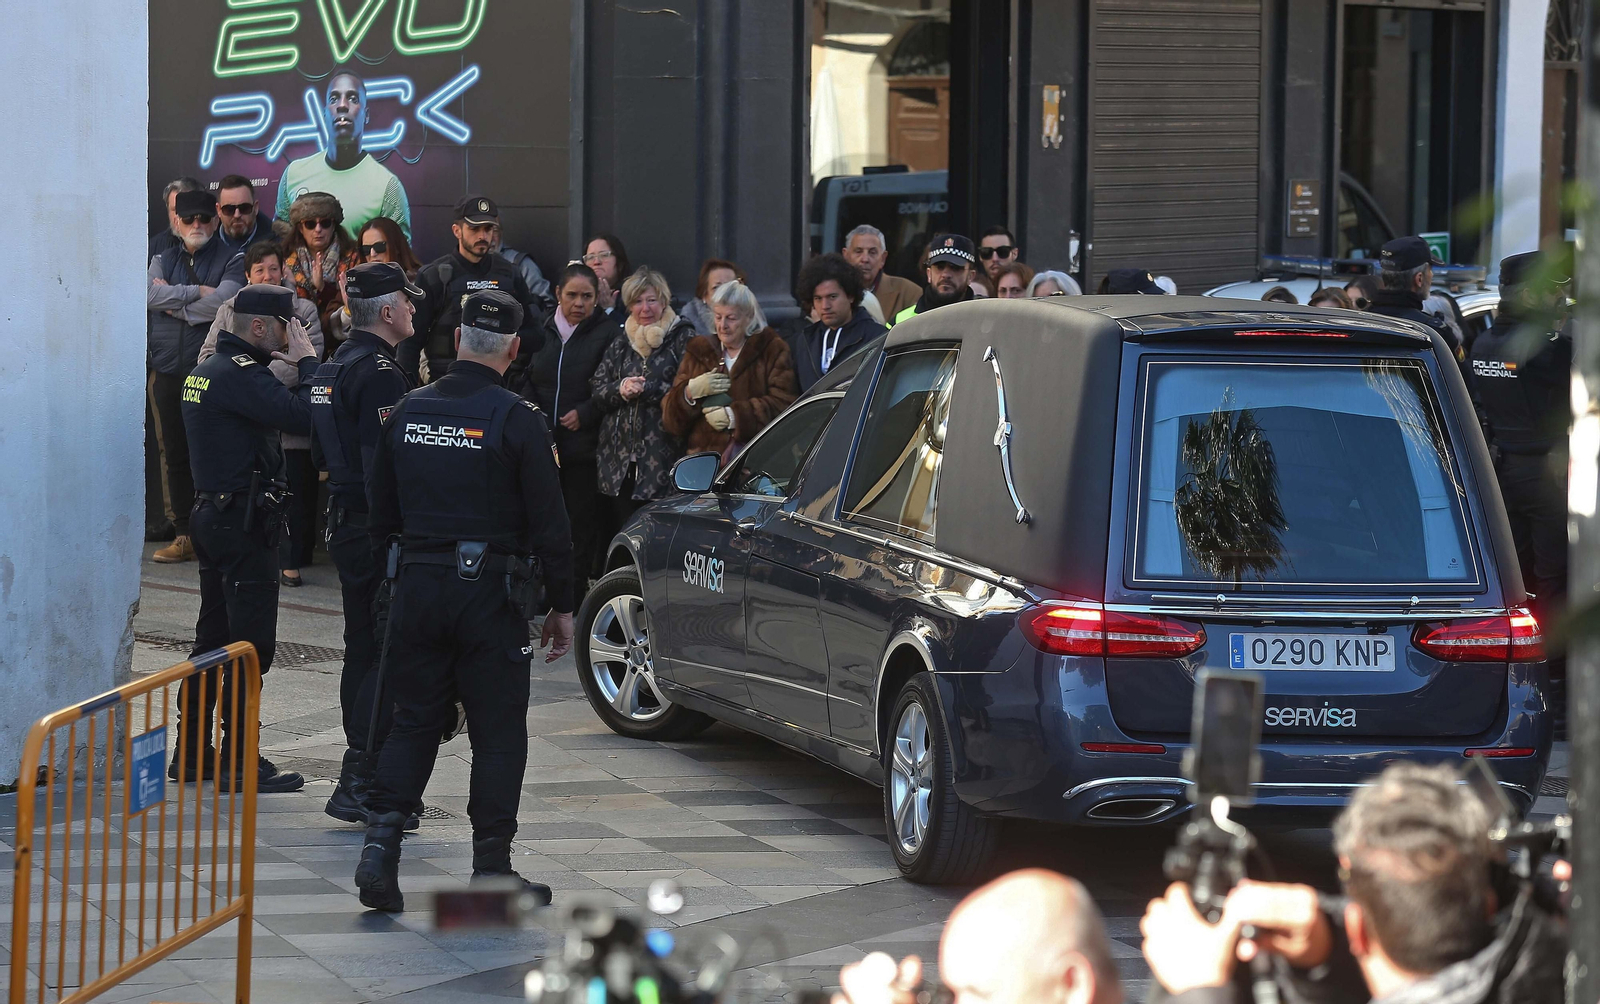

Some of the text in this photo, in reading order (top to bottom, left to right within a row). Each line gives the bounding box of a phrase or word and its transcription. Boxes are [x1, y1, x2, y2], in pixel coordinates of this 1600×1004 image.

[199, 64, 481, 168] PACK
[481, 304, 499, 312] CNP
[1473, 360, 1507, 370] POLICIA
[1474, 369, 1518, 378] NACIONAL
[184, 375, 210, 391] POLICIA
[183, 388, 201, 404] LOCAL
[311, 386, 328, 395] POLICIA
[405, 423, 466, 437] POLICIA
[404, 433, 482, 449] NACIONAL
[1235, 655, 1241, 663] E
[1251, 638, 1389, 667] 0290 KNP
